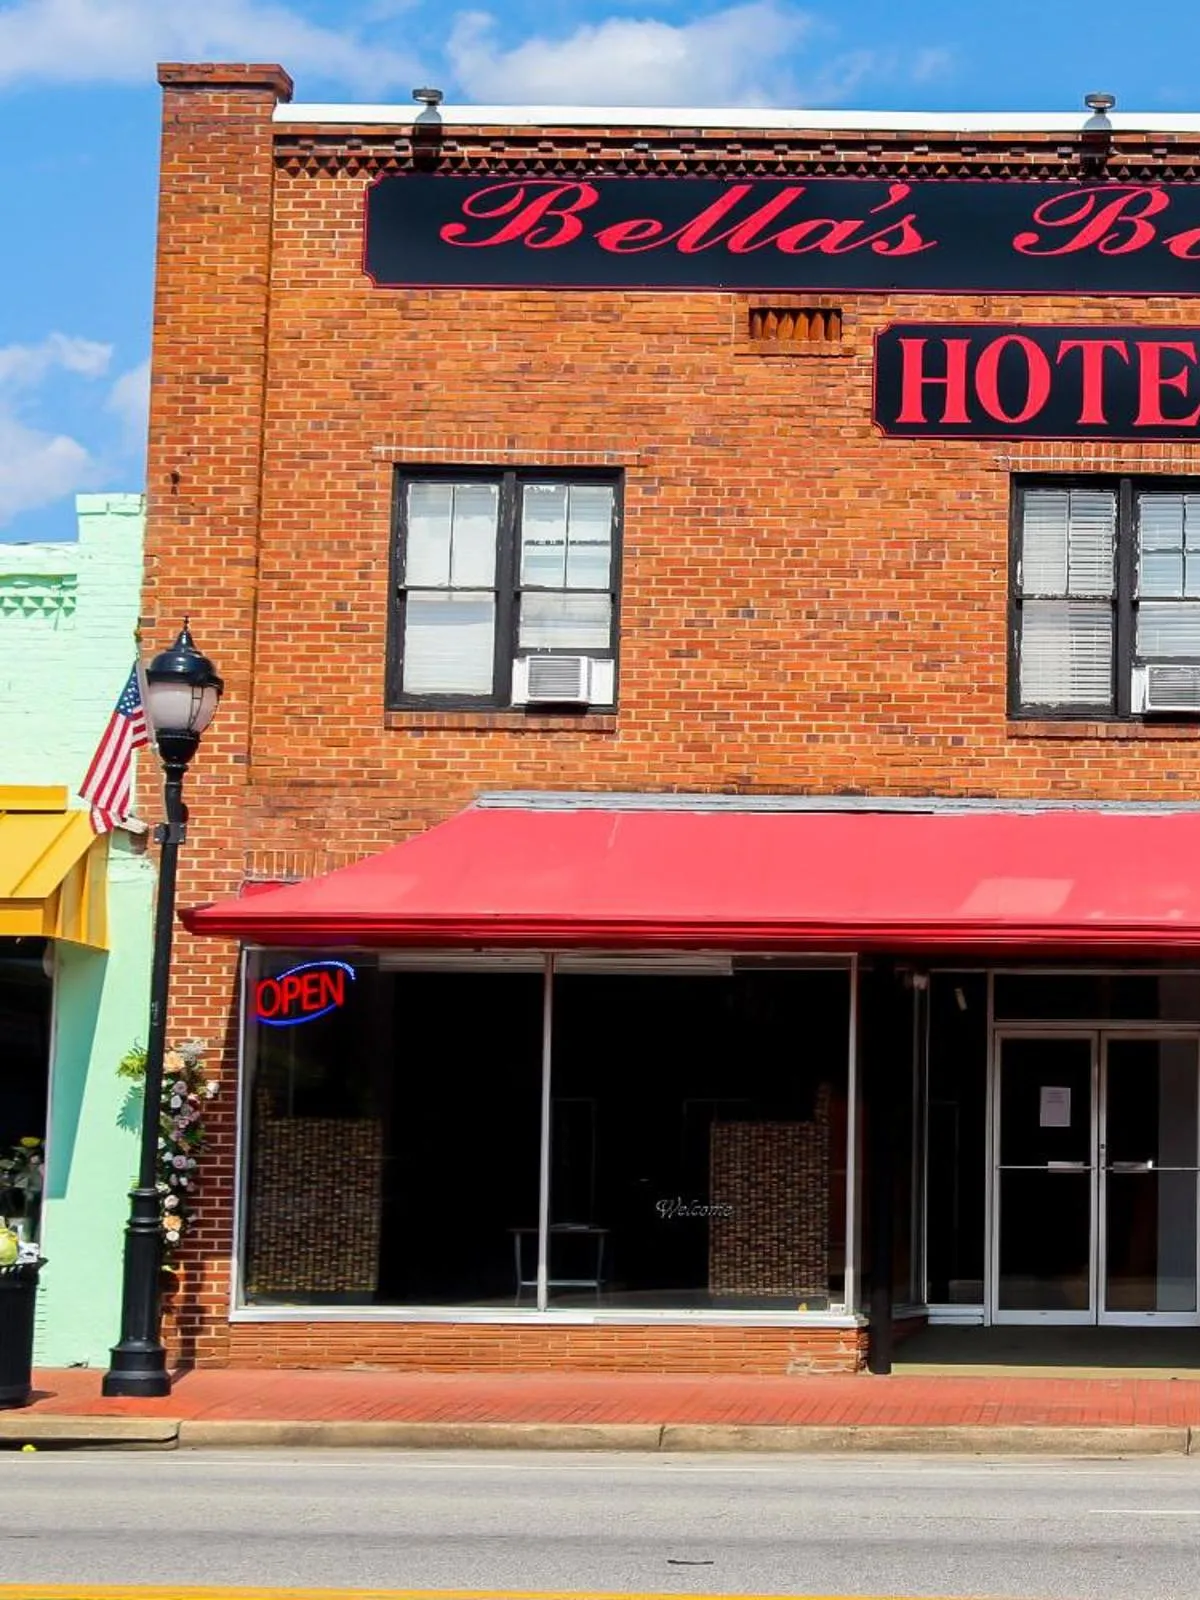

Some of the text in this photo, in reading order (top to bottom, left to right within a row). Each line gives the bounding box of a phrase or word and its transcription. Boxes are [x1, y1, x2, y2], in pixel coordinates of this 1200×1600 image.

[439, 180, 938, 257] Bella's
[256, 968, 345, 1017] OPEN
[655, 1196, 734, 1219] Welcome
